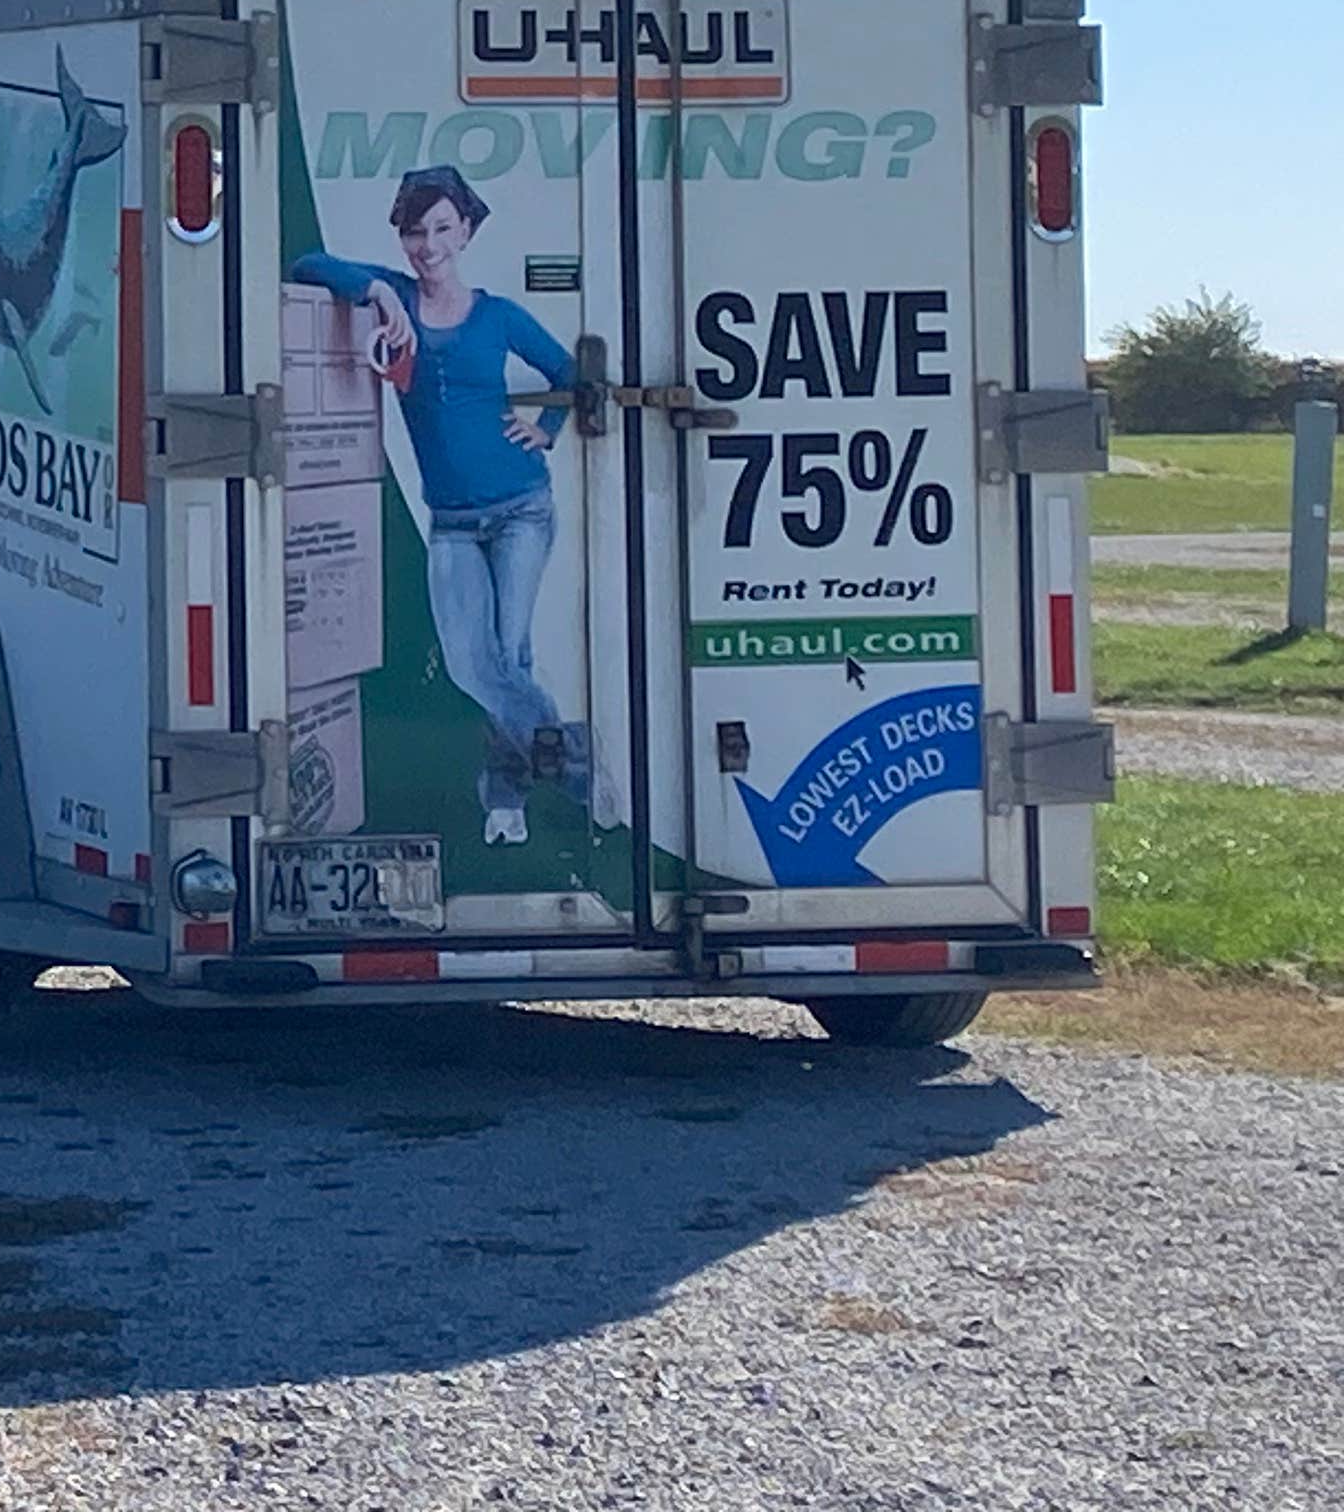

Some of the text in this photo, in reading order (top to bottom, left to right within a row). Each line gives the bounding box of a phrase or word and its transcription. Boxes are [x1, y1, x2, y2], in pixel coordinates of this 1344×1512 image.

[317, 109, 937, 183] MOVING?
[695, 290, 952, 402] SAVE
[34, 430, 101, 523] BAY
[707, 427, 954, 549] 75%
[722, 576, 937, 602] Rent Today!
[705, 627, 961, 657] uhaul.com
[778, 700, 976, 843] LOWEST DECKS
[830, 748, 946, 838] EZ-LOAD
